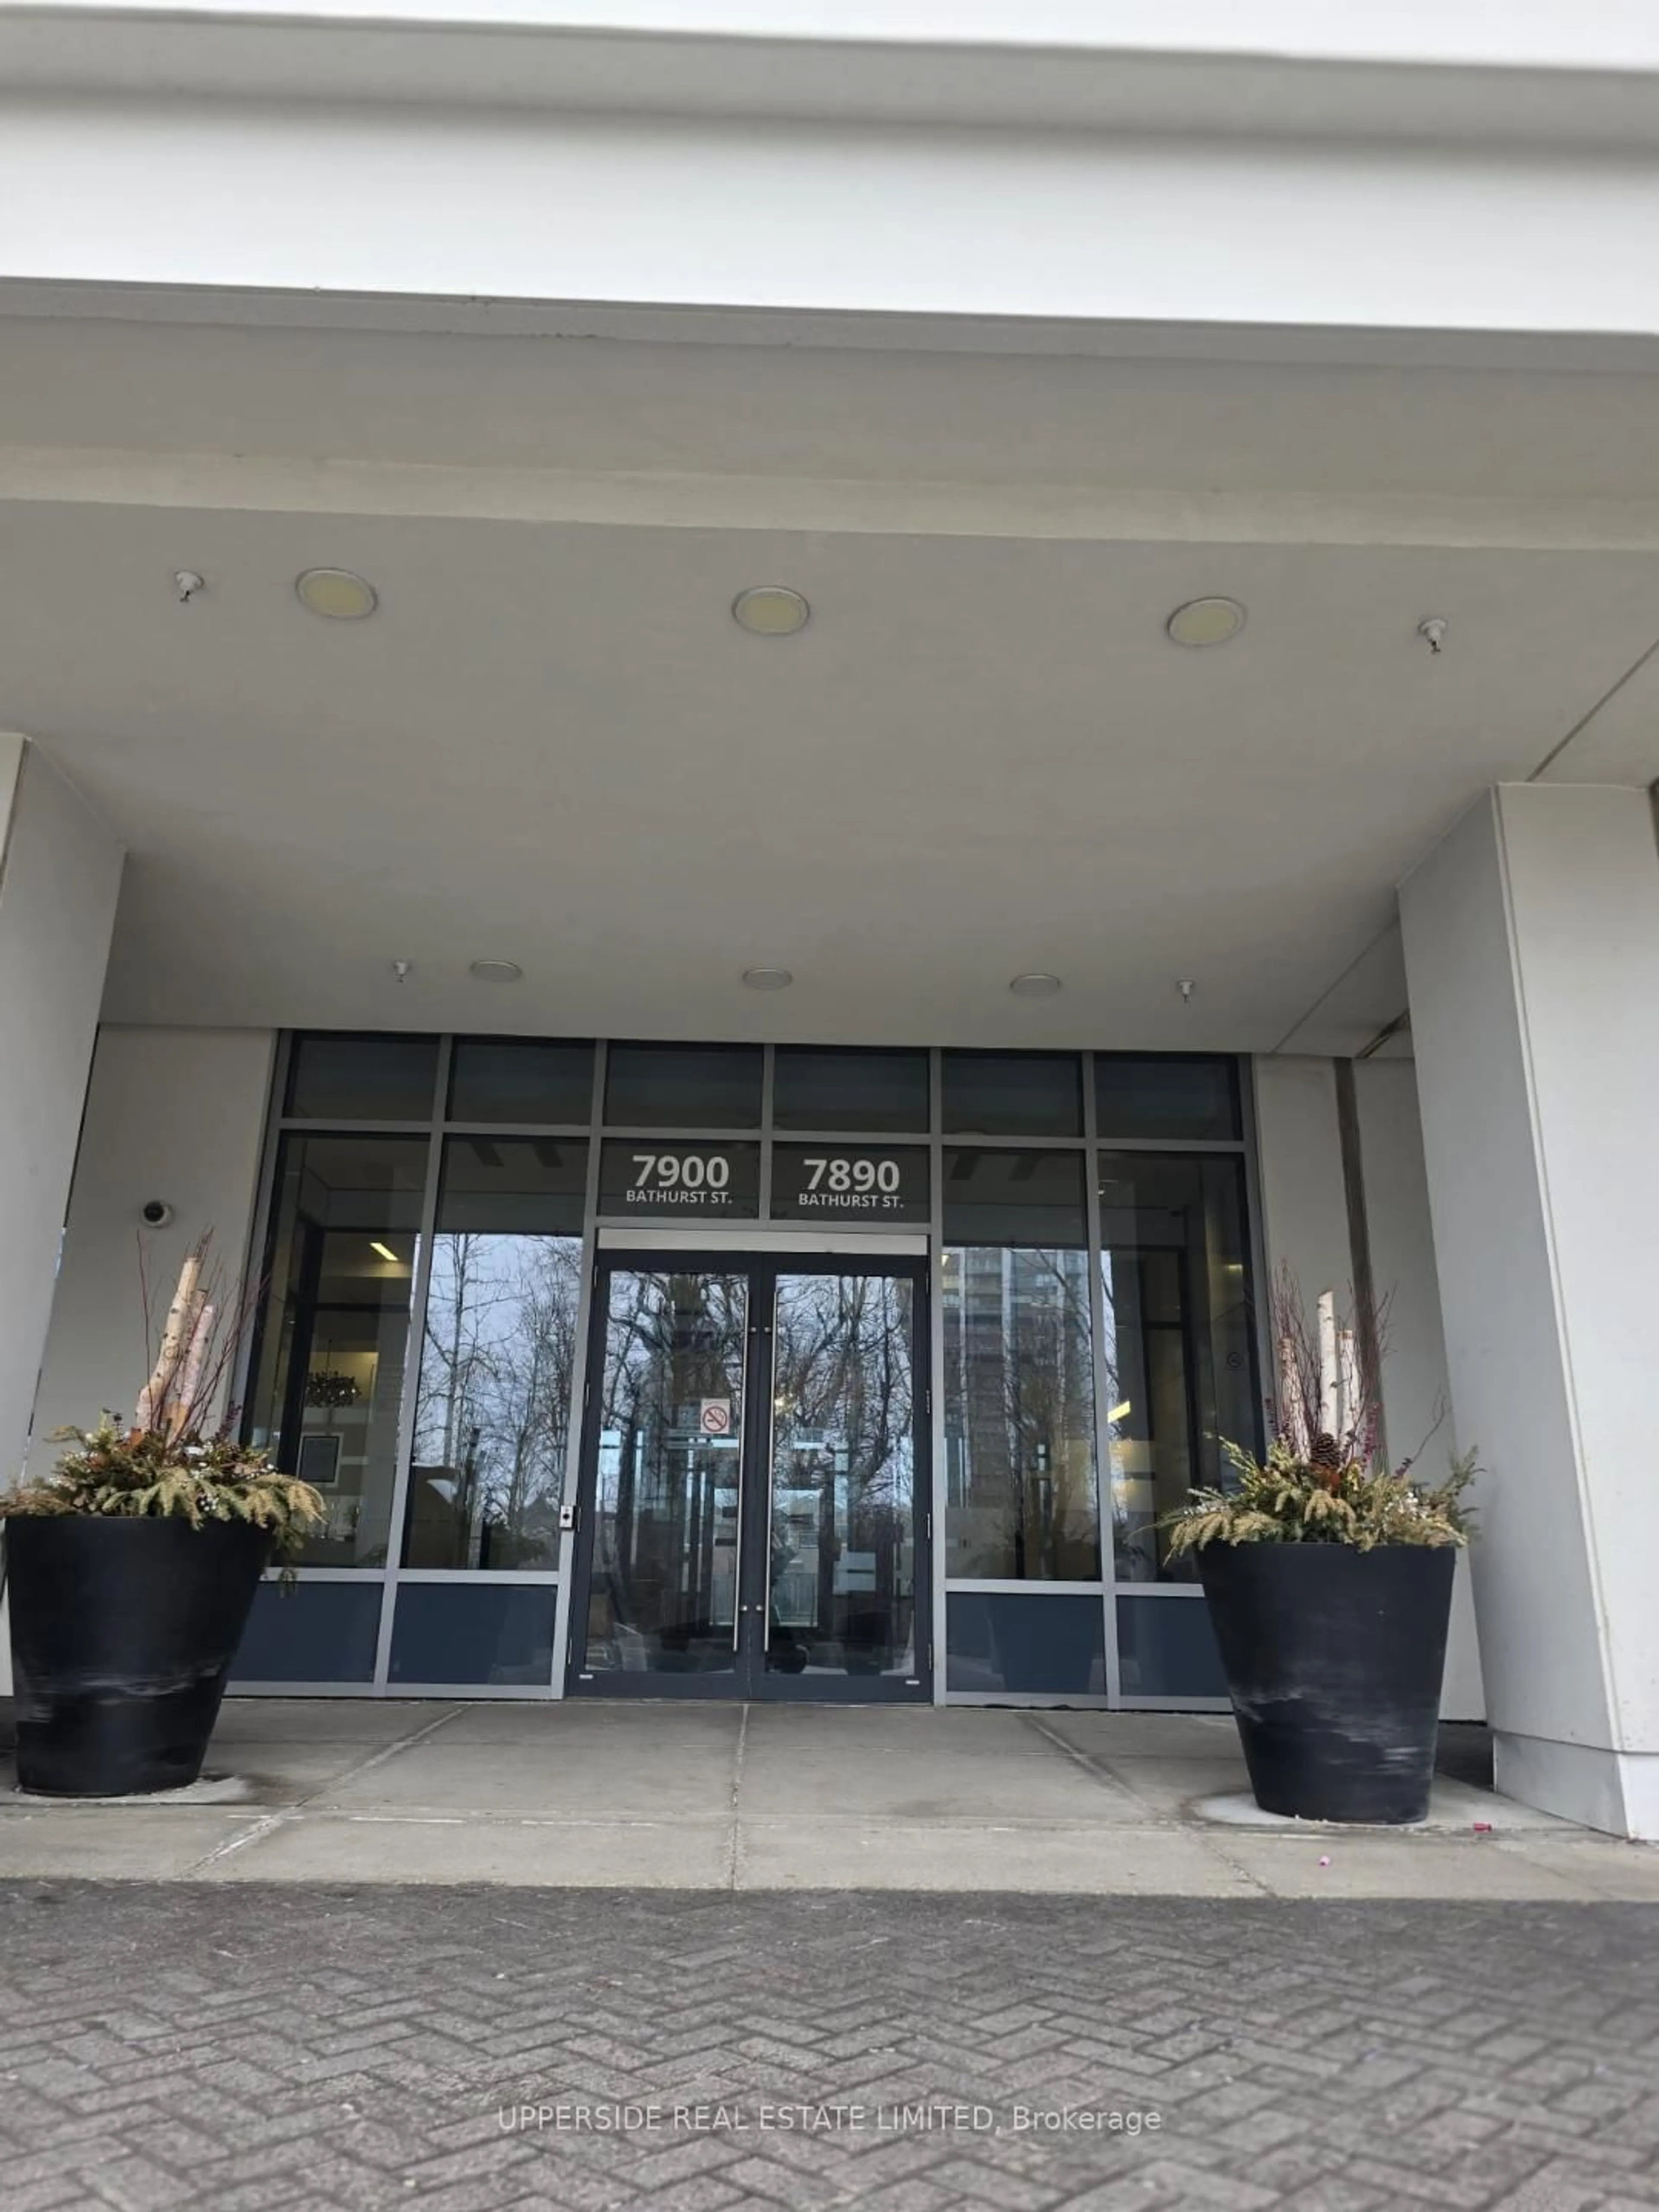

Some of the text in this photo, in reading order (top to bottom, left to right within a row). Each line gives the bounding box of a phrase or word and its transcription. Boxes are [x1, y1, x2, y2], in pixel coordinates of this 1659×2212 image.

[632, 1155, 729, 1188] 7900
[804, 1159, 900, 1192] 7890
[626, 1190, 732, 1204] BATHURST ST.
[799, 1193, 904, 1208] BATHURST ST.
